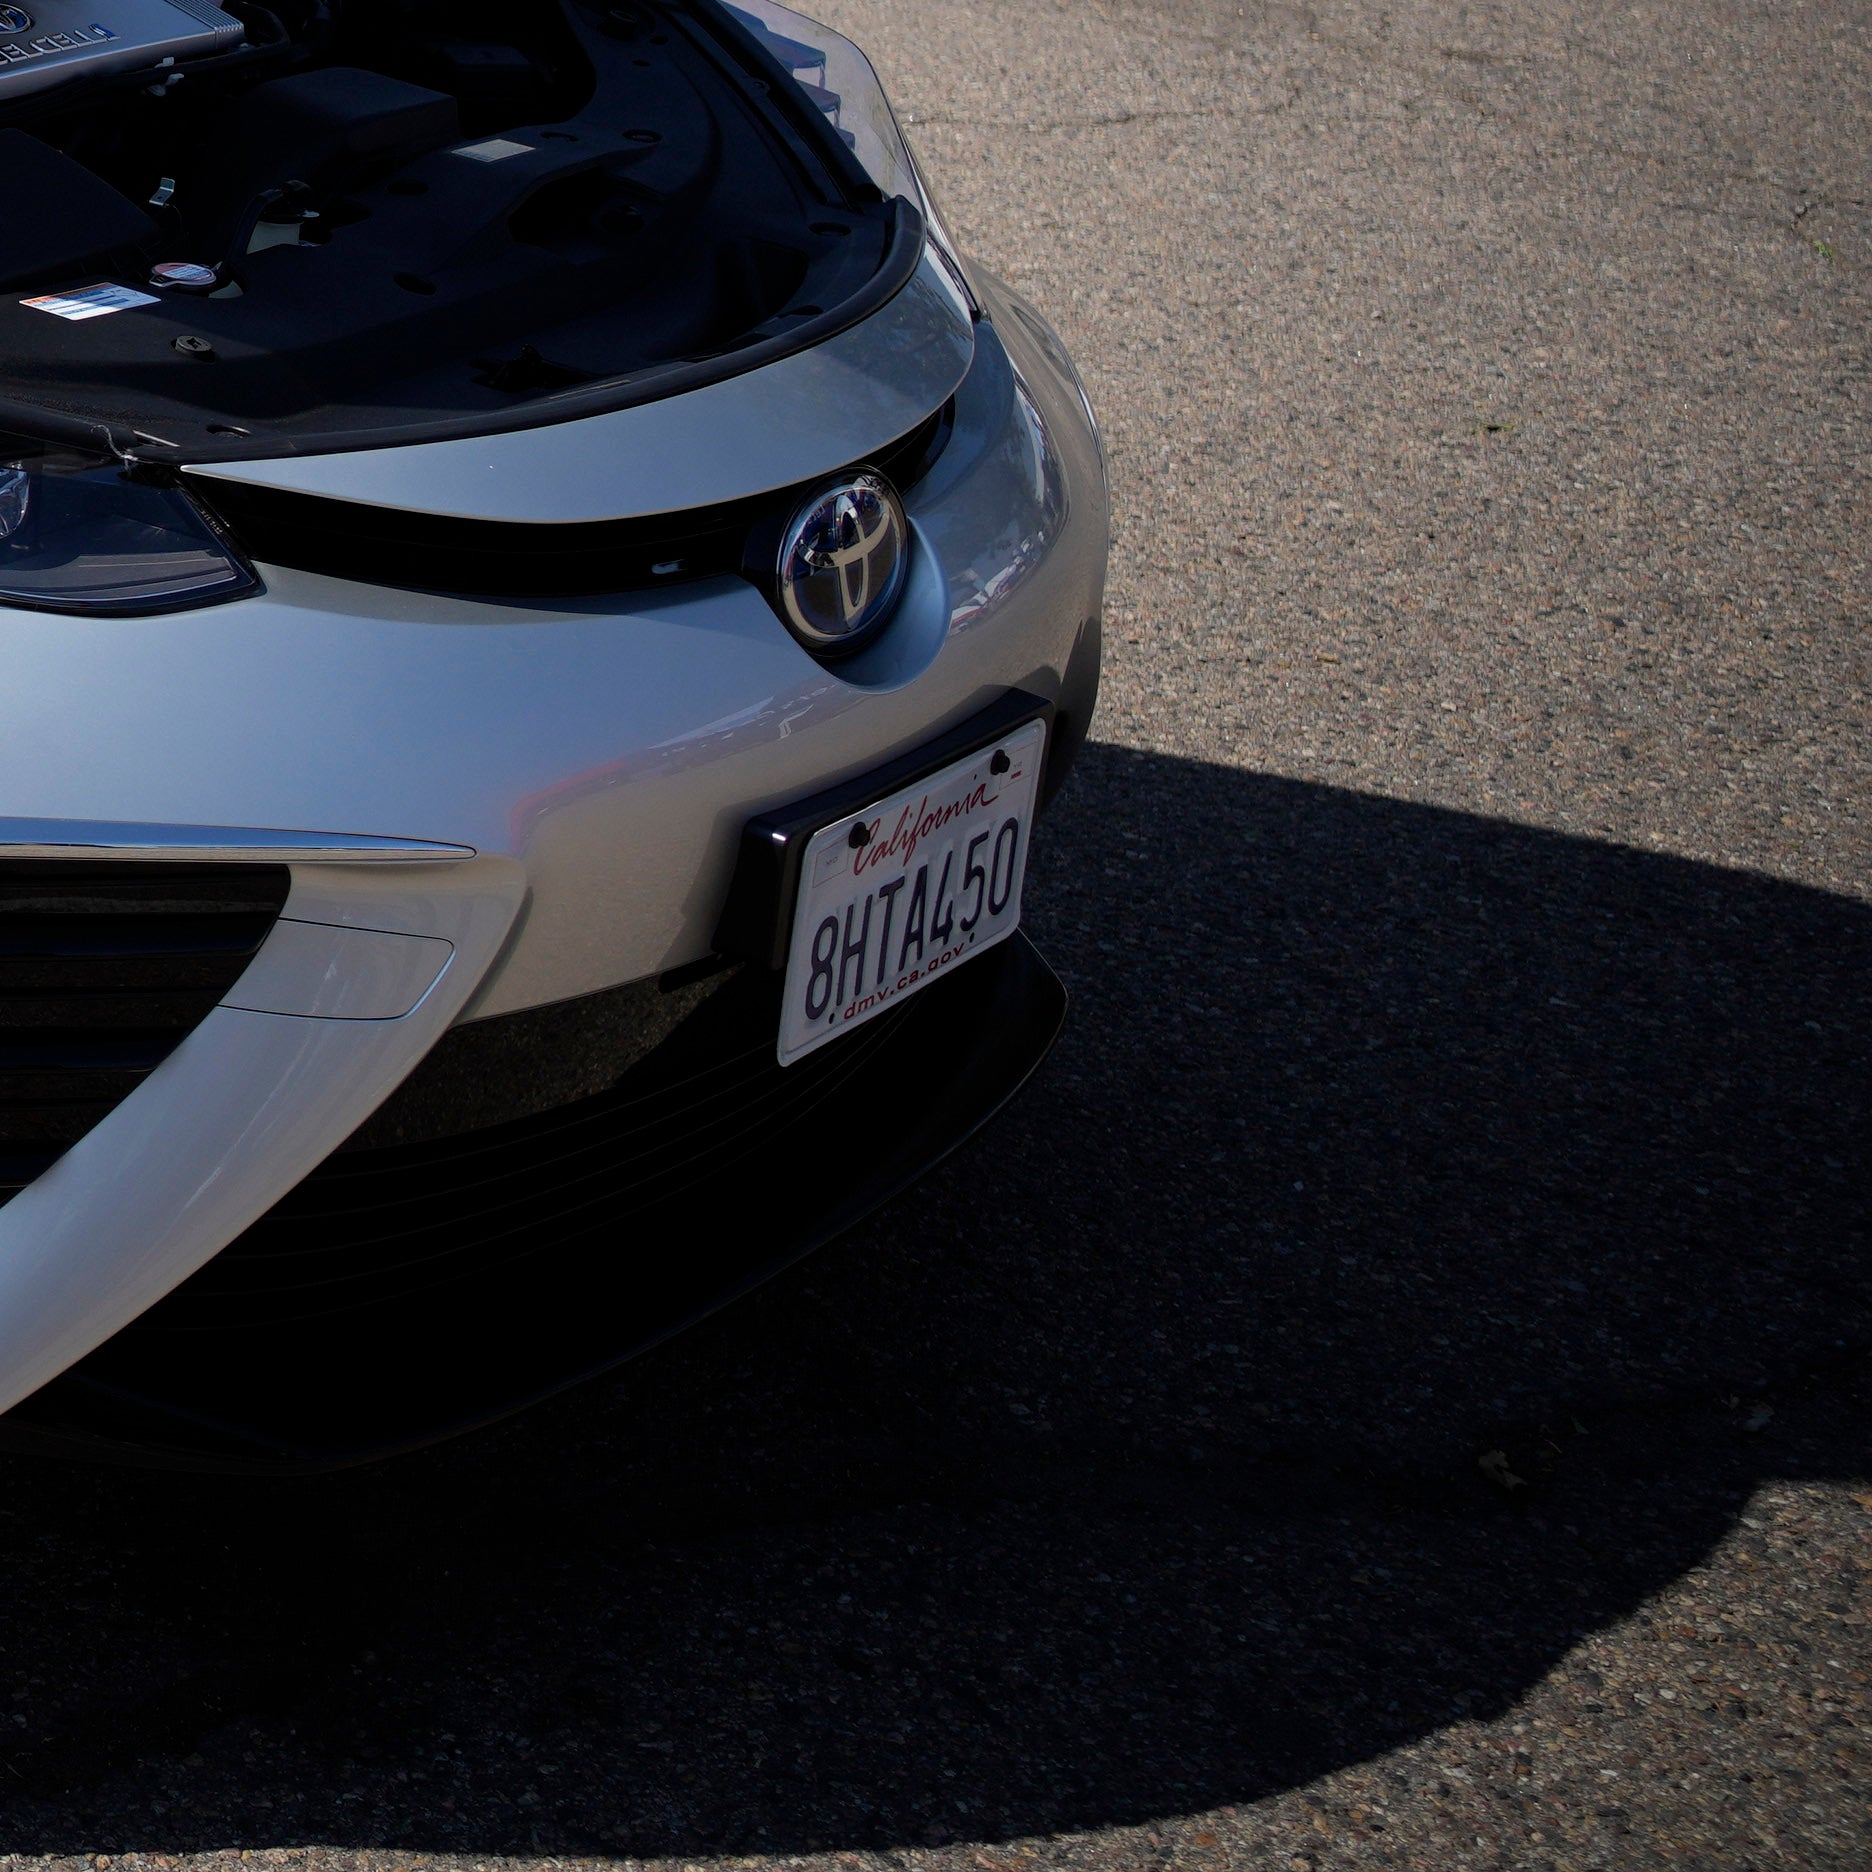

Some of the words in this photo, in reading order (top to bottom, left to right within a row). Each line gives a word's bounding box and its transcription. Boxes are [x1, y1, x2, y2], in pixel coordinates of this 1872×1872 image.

[853, 774, 999, 877] California
[805, 816, 1019, 1020] 8HTA450
[843, 943, 965, 1022] dmv.ca.gov
